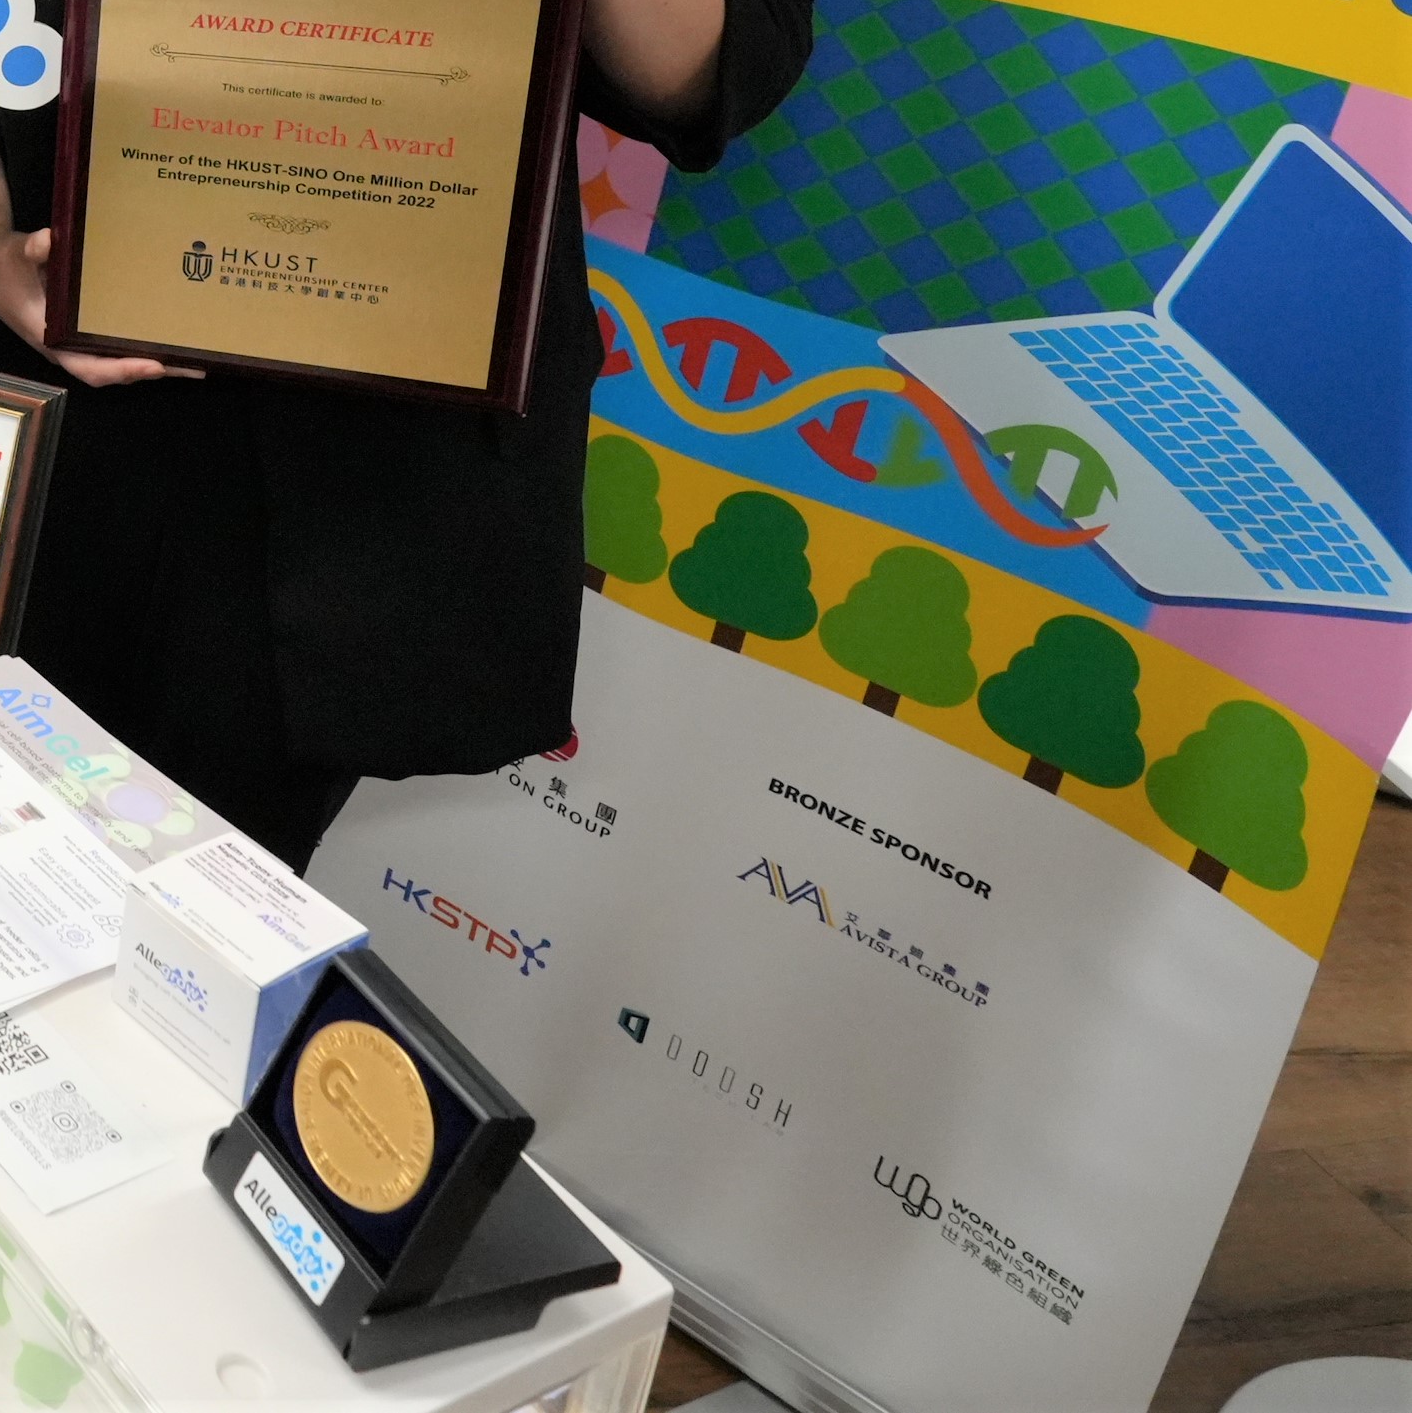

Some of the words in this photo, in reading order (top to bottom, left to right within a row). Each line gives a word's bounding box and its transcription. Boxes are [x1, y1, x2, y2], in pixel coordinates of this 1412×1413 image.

[151, 108, 264, 138] Elevator
[275, 119, 348, 147] Pitch
[358, 129, 455, 157] Award
[122, 148, 173, 162] Winner
[178, 153, 196, 166] of
[198, 157, 221, 168] the
[227, 159, 327, 179] HKUST-SINO
[333, 171, 365, 183] One
[371, 175, 423, 190] Million
[430, 181, 478, 196] Dollar
[158, 168, 290, 194] Entrepreneurship
[296, 183, 391, 203] Competition
[397, 195, 435, 208] 2022
[221, 266, 338, 286] ENTREPRENEURSHIP
[343, 282, 388, 293] CENTER
[222, 247, 318, 273] HKUST
[543, 795, 611, 838] GROUP
[768, 778, 866, 836] BRONZE
[869, 827, 992, 900] SPONSOR
[382, 868, 518, 959] HKSTP
[840, 924, 911, 968] AVISTA
[916, 964, 987, 1007] GROUP
[244, 1178, 327, 1285] Allegrow
[948, 1212, 1079, 1309] ORGANISATION
[952, 1198, 1016, 1250] WORLD
[1022, 1251, 1084, 1299] GREEN
